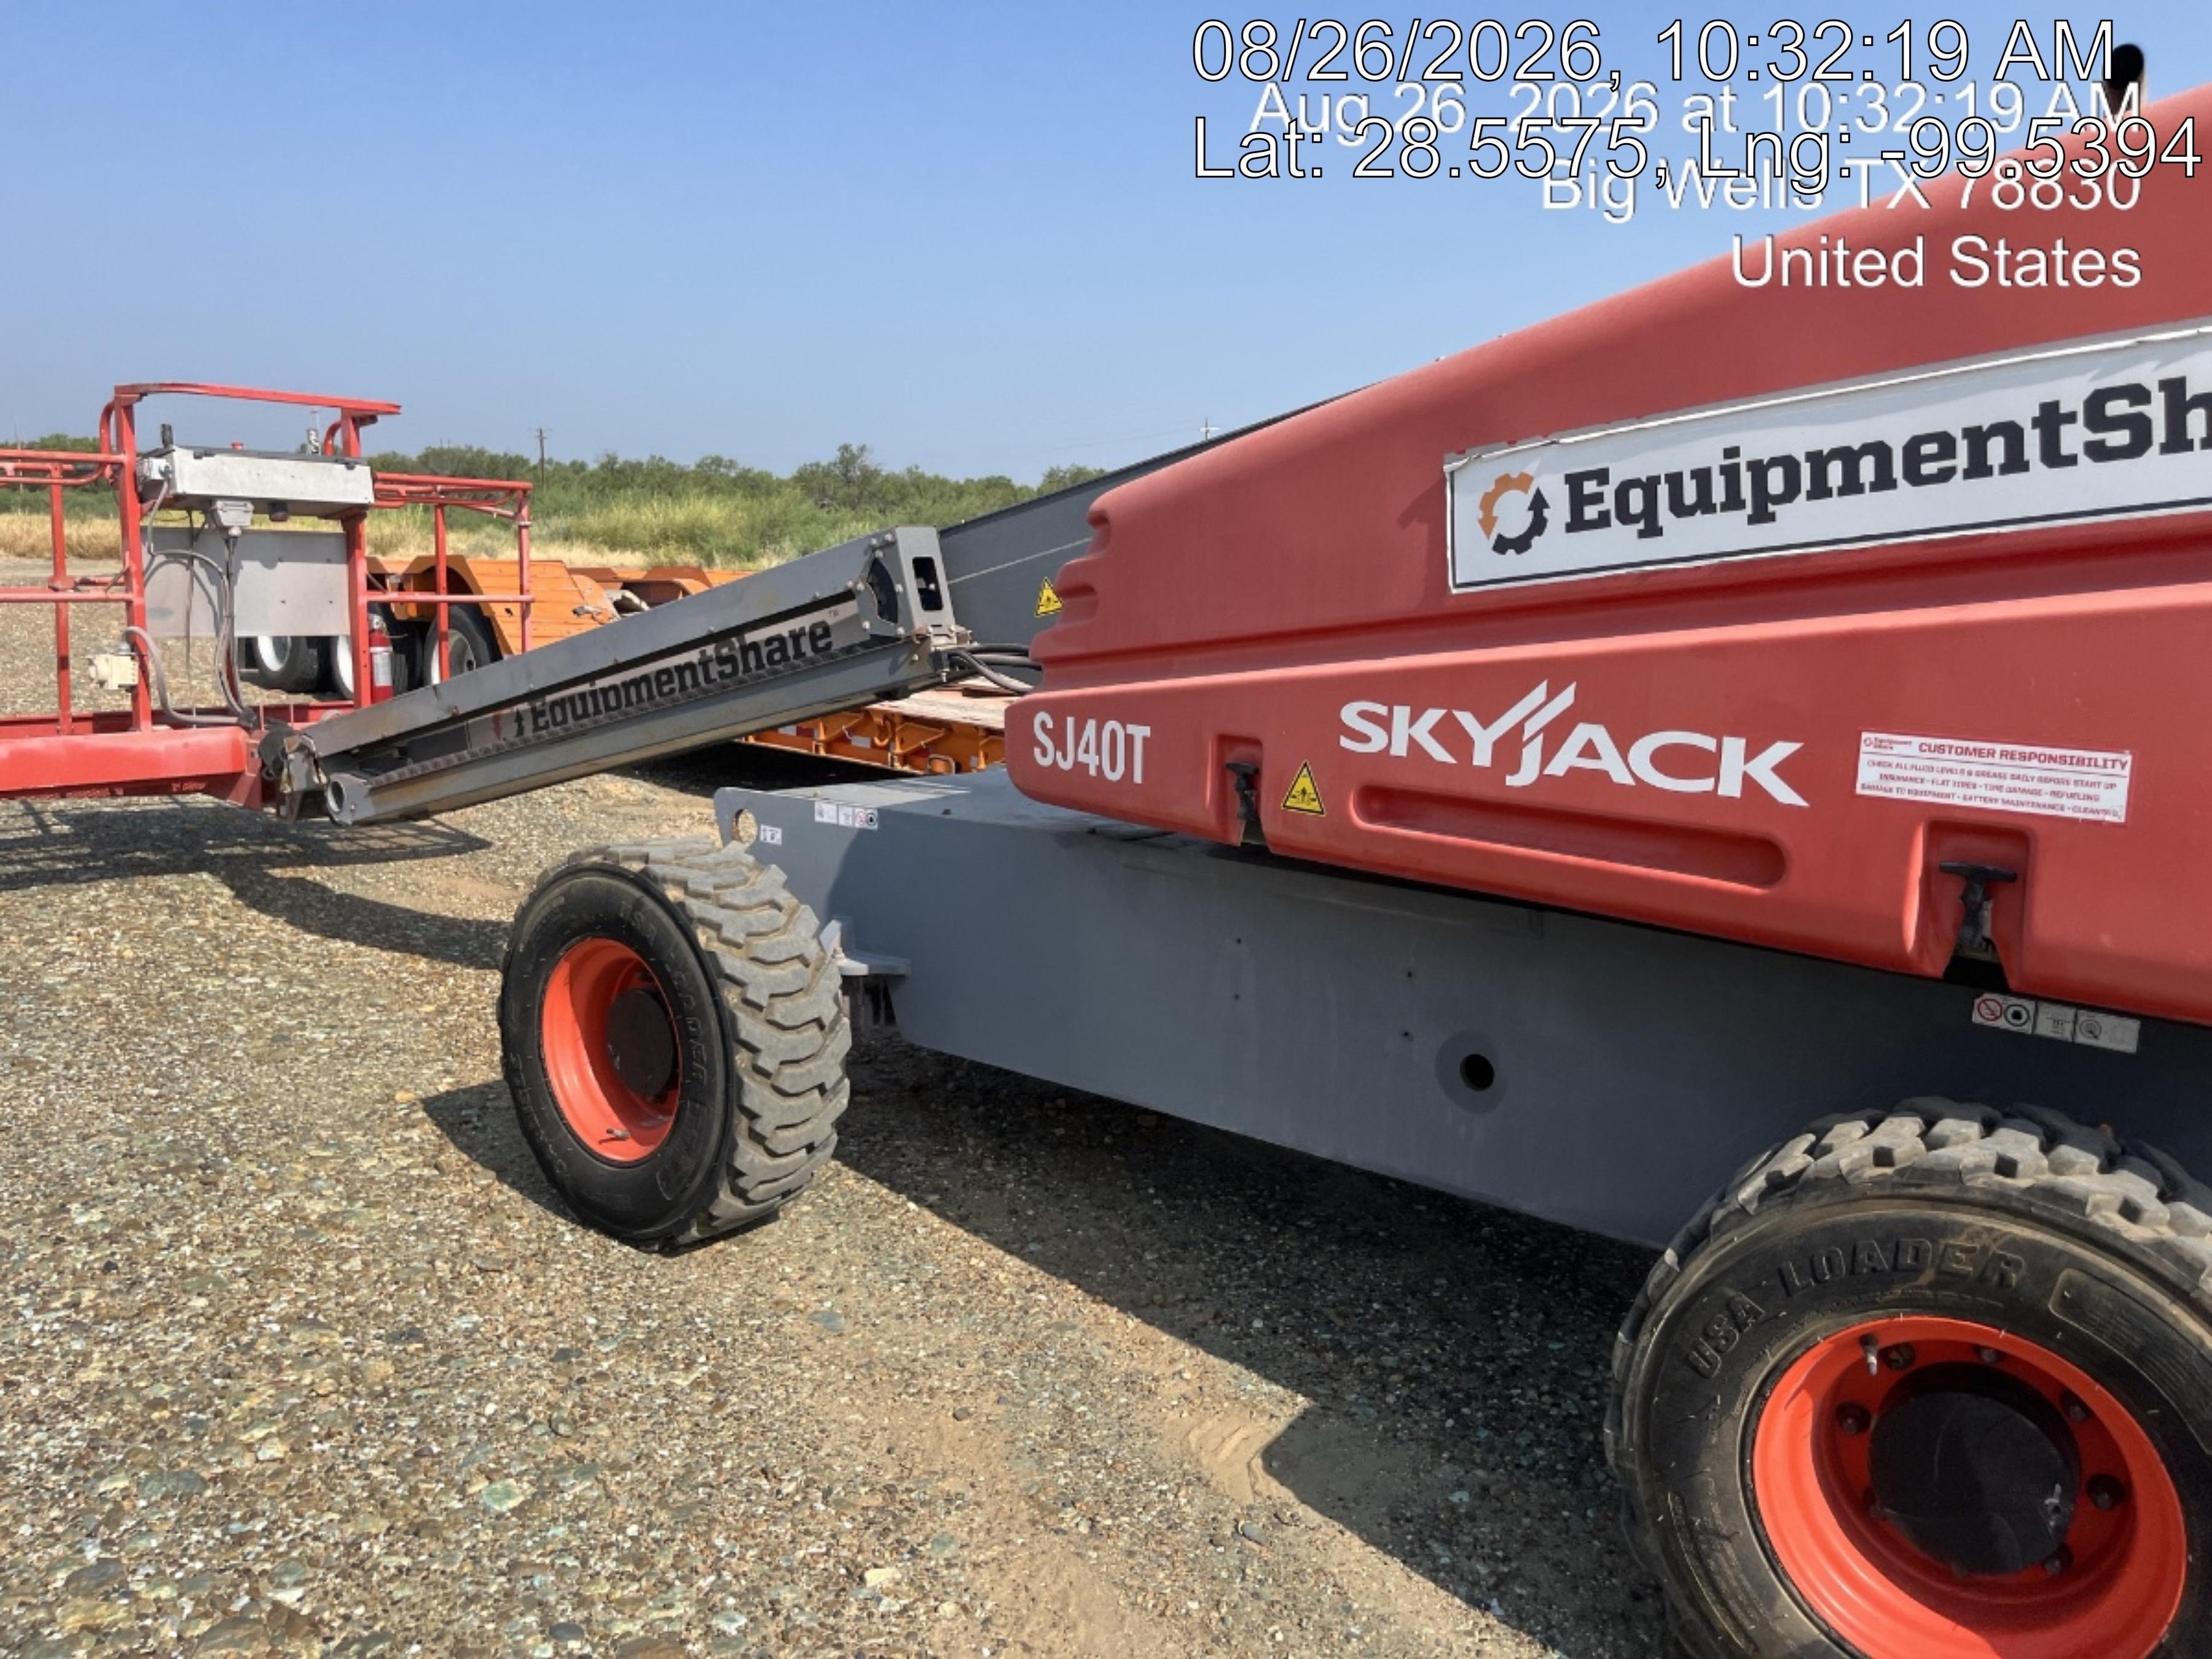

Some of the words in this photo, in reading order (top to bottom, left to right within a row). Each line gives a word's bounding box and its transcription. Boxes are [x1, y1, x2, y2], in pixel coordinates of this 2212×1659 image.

[1564, 376, 2212, 538] EquipmentSh
[530, 619, 833, 732] EquipmentShare
[1033, 711, 1151, 785] SJ40T
[1339, 680, 1810, 807] SKYJACK
[1918, 742, 1996, 758] CUSTOMER
[1686, 1292, 1765, 1379] USA
[1778, 1237, 2026, 1298] LOADER
